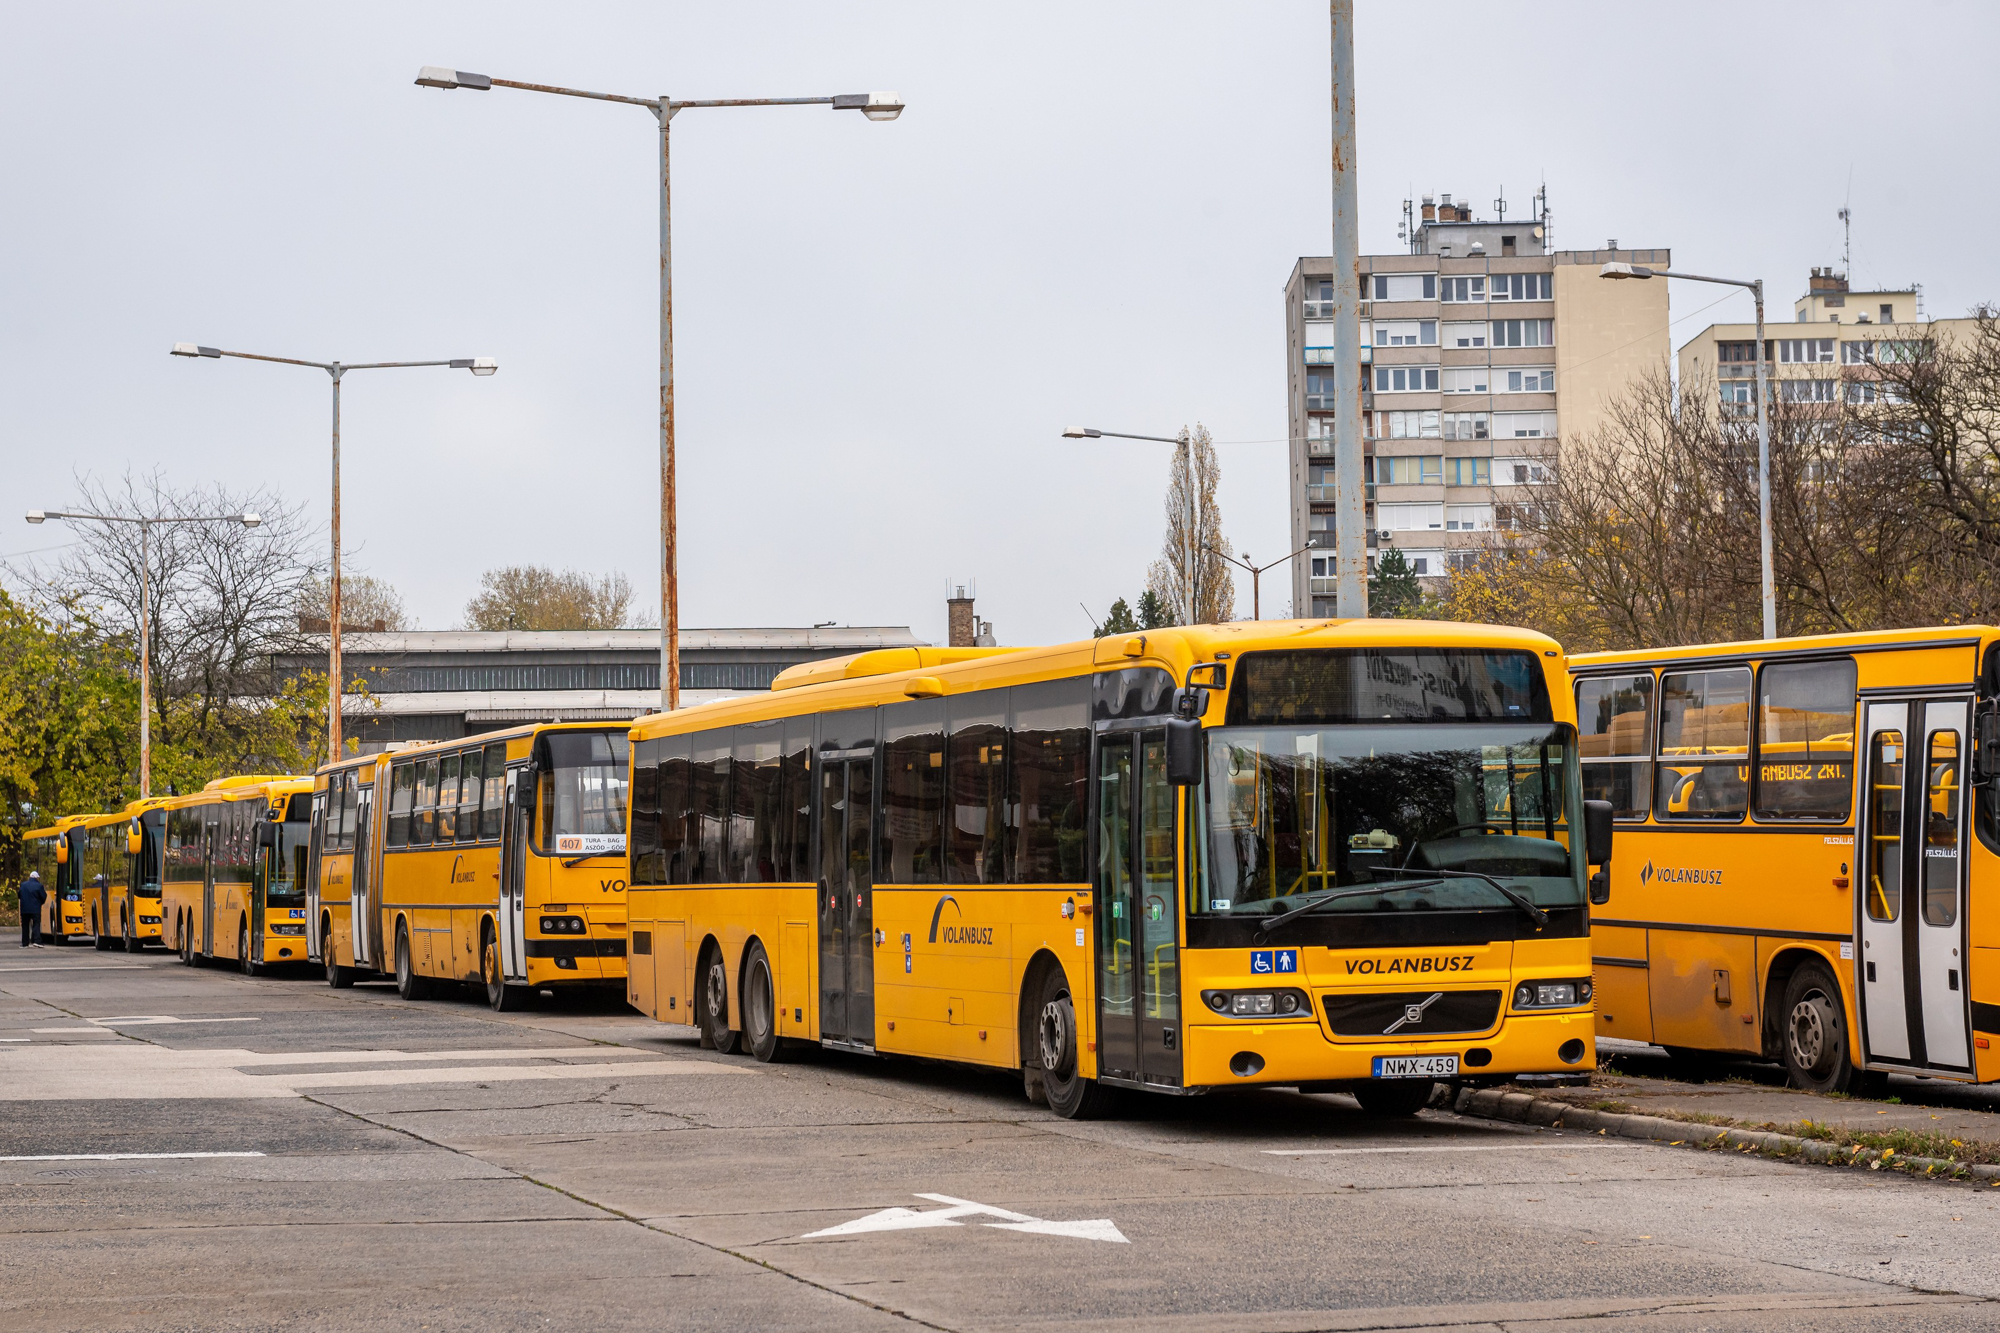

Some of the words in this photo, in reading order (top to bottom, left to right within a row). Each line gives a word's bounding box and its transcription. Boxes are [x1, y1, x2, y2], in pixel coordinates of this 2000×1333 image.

[561, 840, 580, 849] 407
[1823, 836, 1854, 845] FELSZÁLLÁS
[1925, 848, 1957, 858] FELSZÁLLÁS
[1345, 955, 1475, 975] VOLÁNBUSZ
[1385, 1058, 1455, 1075] NWX-459
